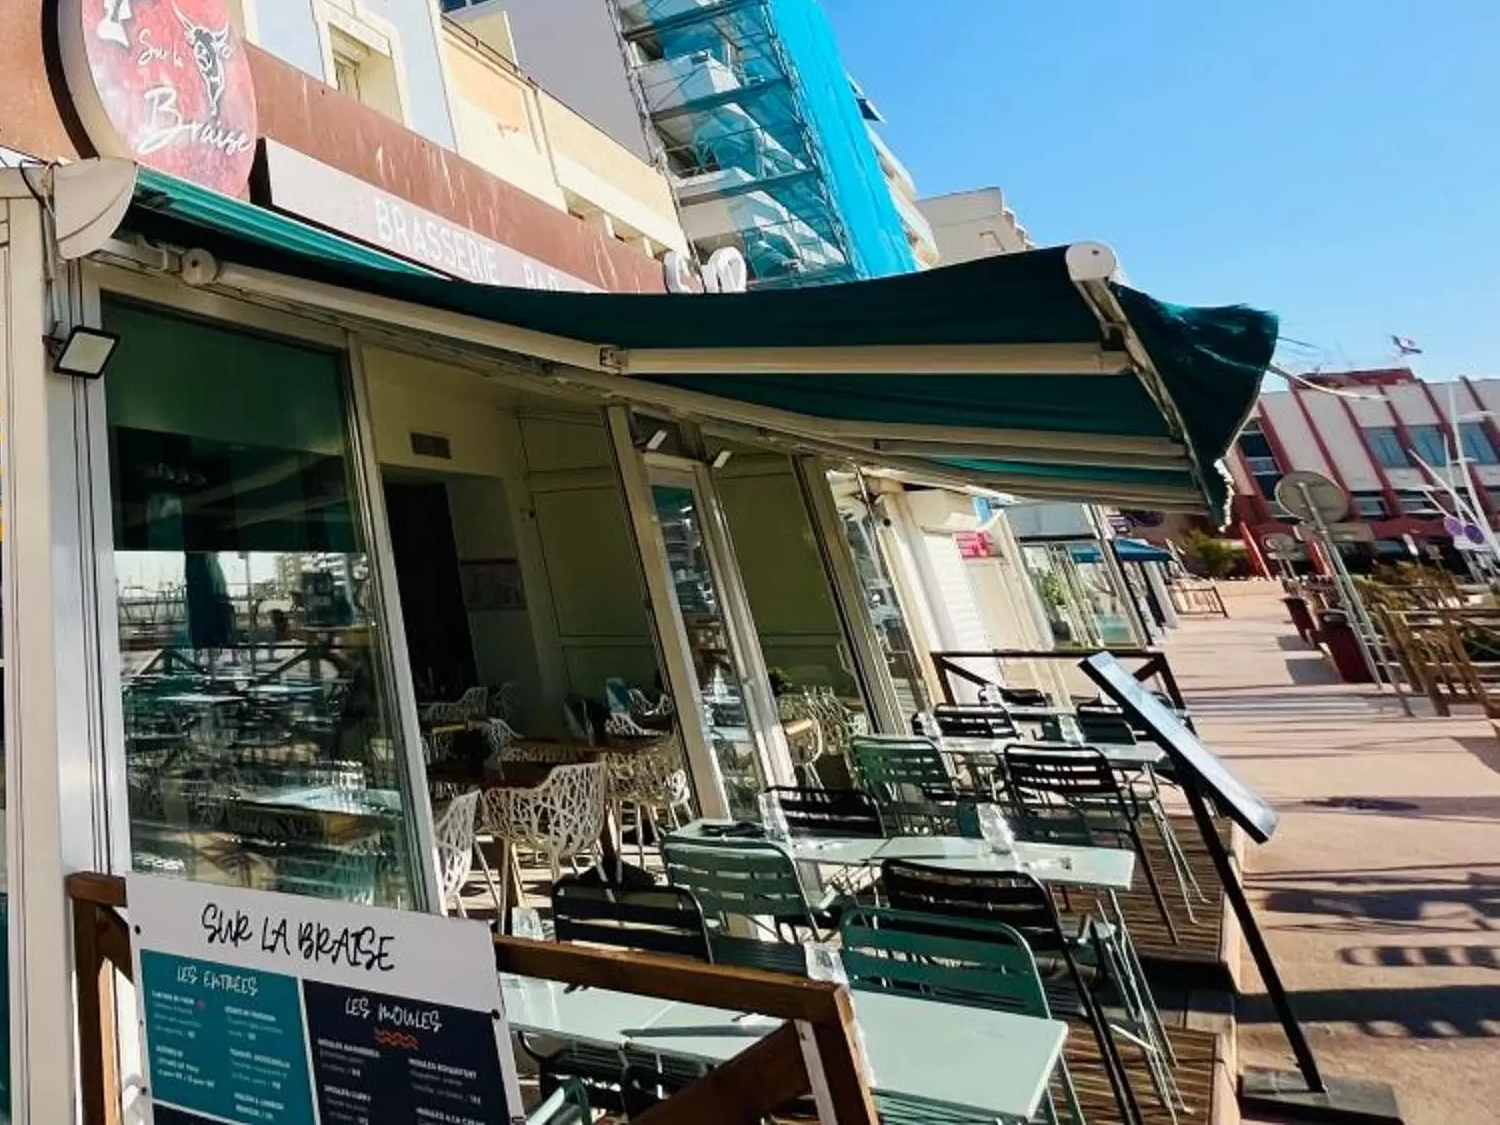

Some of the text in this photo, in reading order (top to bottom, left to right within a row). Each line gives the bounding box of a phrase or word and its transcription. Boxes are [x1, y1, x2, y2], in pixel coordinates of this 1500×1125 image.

[137, 85, 253, 156] Braise
[201, 902, 395, 972] SUR LA BRAISE
[345, 996, 443, 1033] LES MOULES
